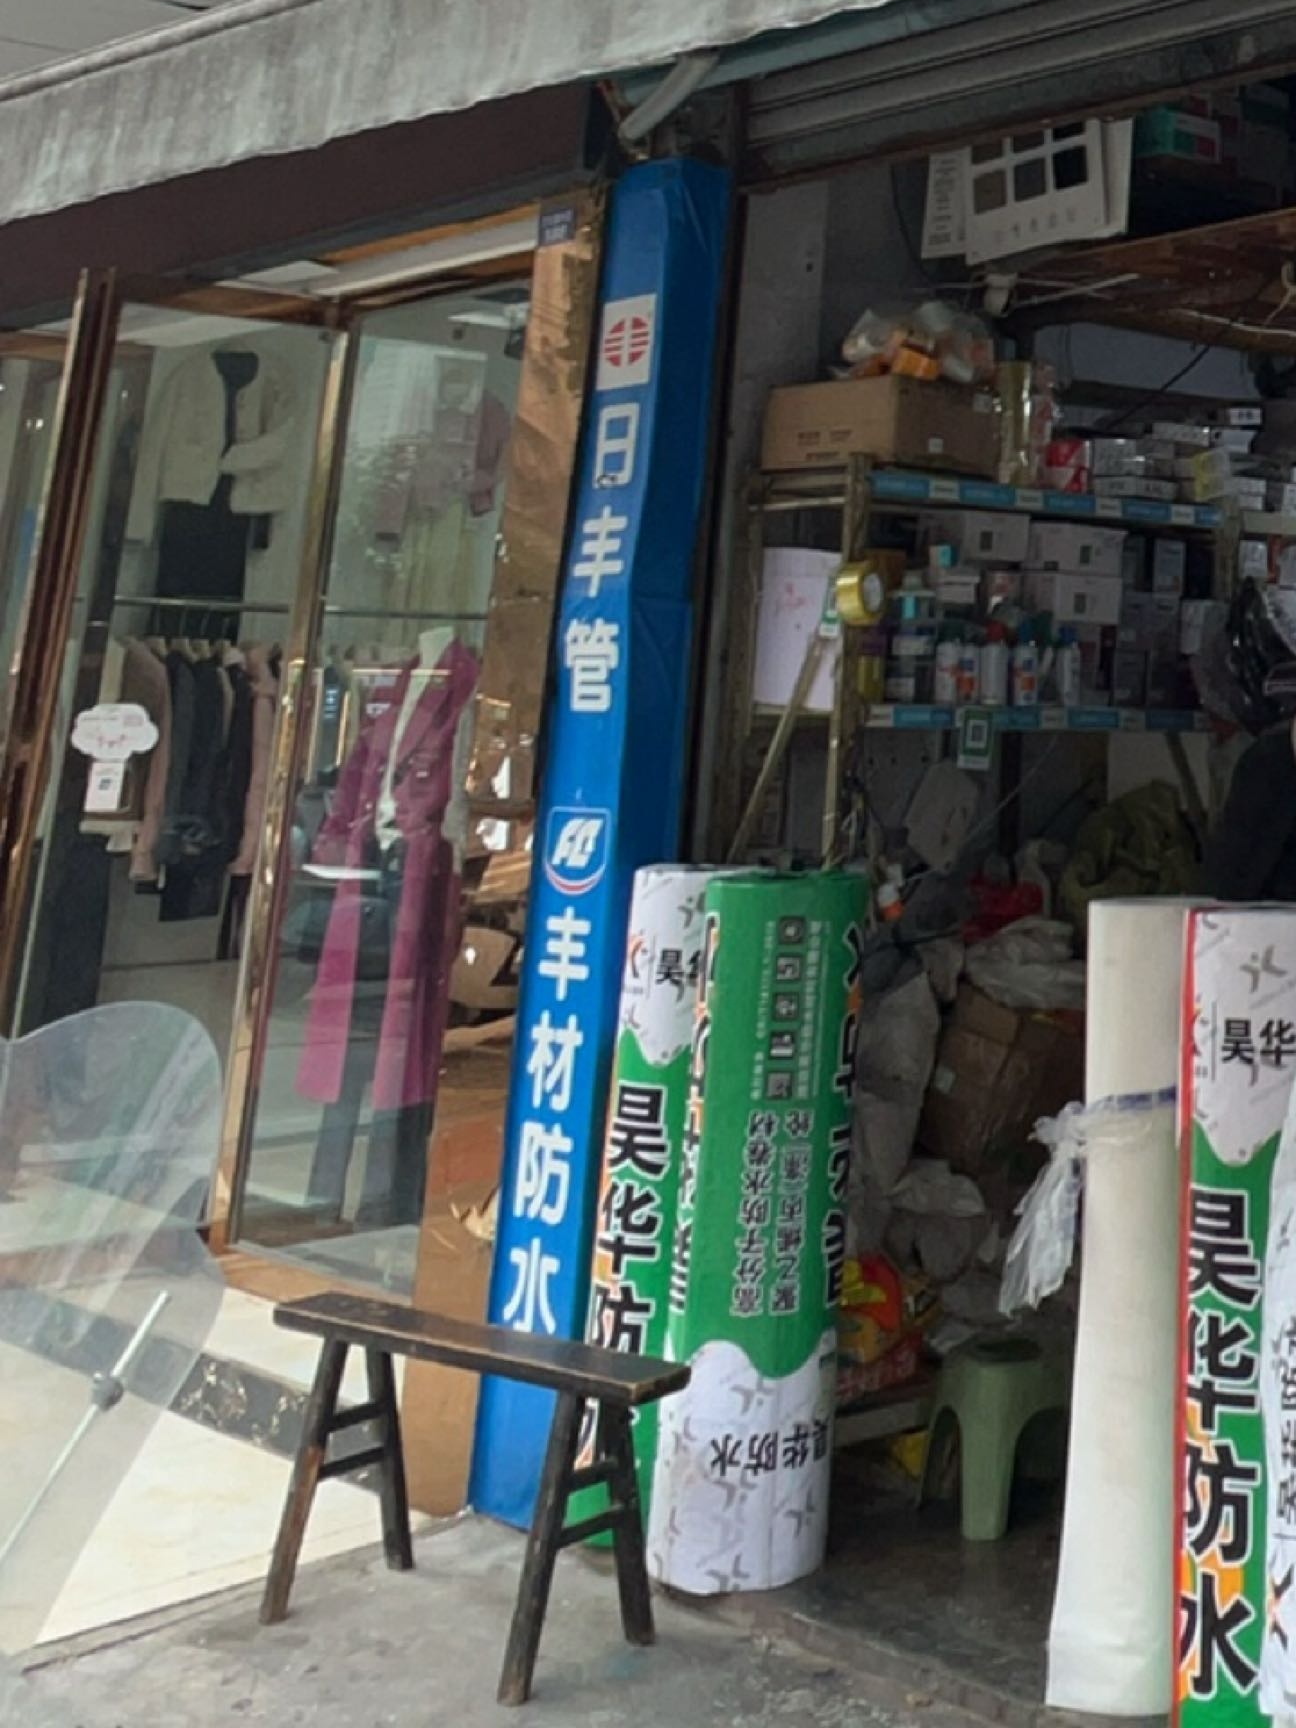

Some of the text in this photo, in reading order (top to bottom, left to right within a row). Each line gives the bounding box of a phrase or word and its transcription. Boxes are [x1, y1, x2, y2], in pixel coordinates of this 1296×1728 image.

[564, 402, 640, 713] 日丰管
[501, 906, 593, 1334] 丰材防水
